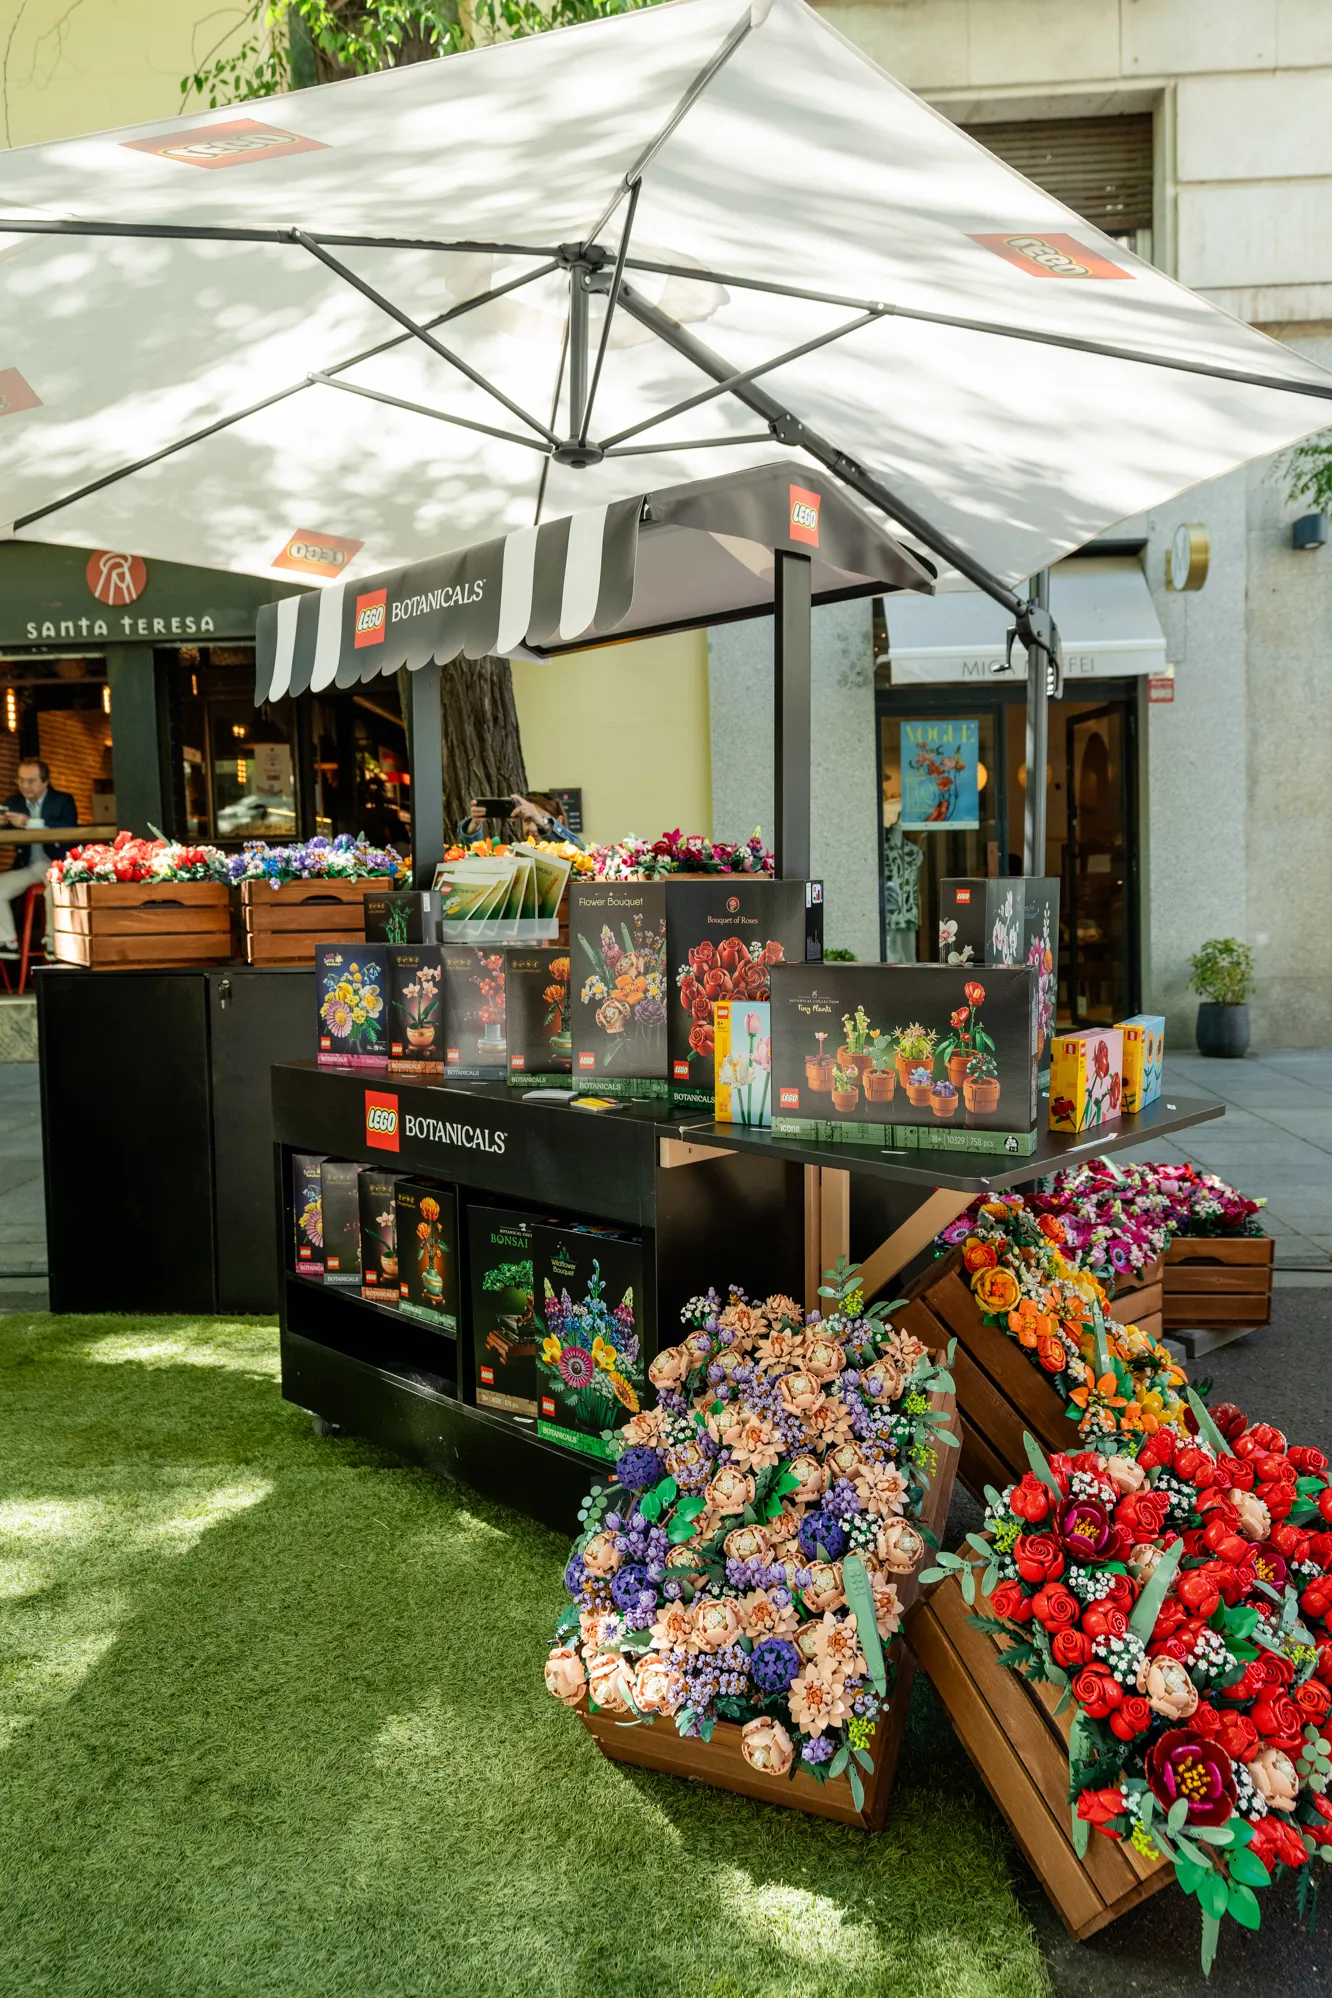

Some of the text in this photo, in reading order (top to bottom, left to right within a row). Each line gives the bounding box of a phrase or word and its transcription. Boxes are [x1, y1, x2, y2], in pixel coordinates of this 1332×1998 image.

[793, 502, 817, 530] LEGO
[357, 579, 486, 633] LEGO BOTANICALS
[905, 723, 976, 744] VOGUE
[578, 897, 644, 908] Flower Bouquet
[707, 915, 759, 925] Bouquet of Roses
[797, 1003, 832, 1015] Tiny Plants
[579, 1057, 595, 1065] LEGO
[674, 1066, 689, 1074] LEGO
[579, 1082, 621, 1090] BOTANICALS
[674, 1092, 715, 1104] BOTANICALS
[781, 1093, 799, 1103] LEGO
[367, 1107, 507, 1154] LEGO BOTANICALS
[931, 1134, 994, 1148] 18+ 10329 758 pcs
[490, 1233, 529, 1248] BONSAI
[550, 1258, 577, 1271] Wildflower
[552, 1265, 575, 1277] Bouquet
[542, 1426, 577, 1444] BOTANICALS
